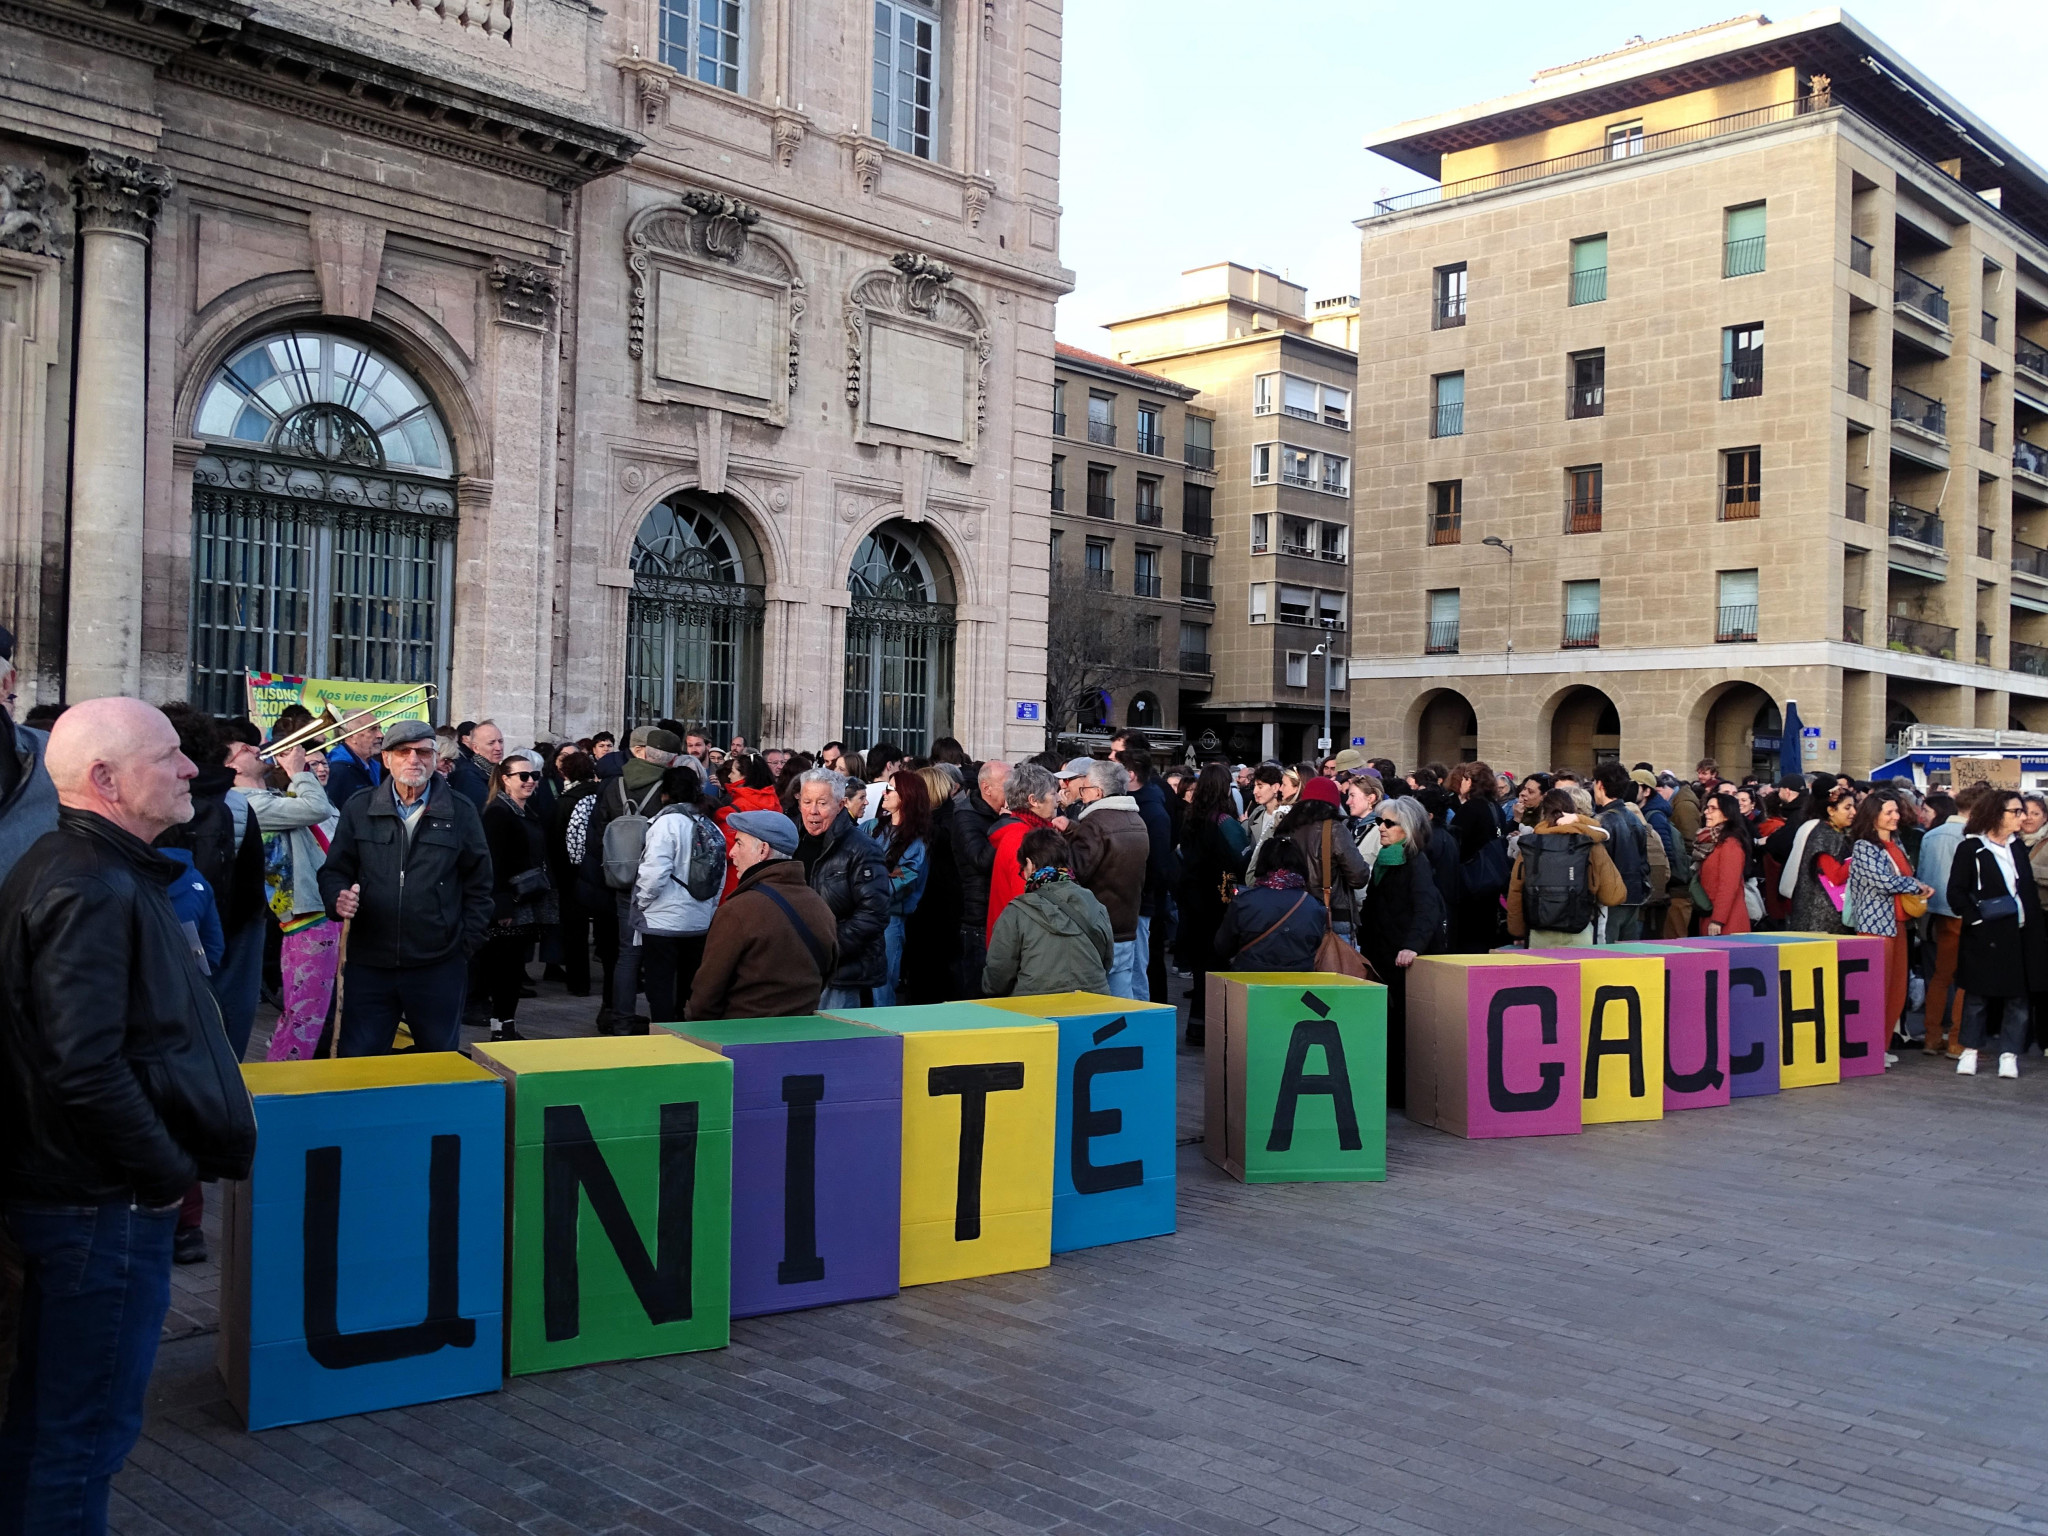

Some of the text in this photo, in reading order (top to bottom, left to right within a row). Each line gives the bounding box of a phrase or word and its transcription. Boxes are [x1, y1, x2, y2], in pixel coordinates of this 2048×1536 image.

[252, 687, 298, 701] FAISONS
[316, 688, 342, 701] Nos
[344, 691, 368, 702] vies
[304, 958, 1870, 1369] UNITÉ À GAUCHE
